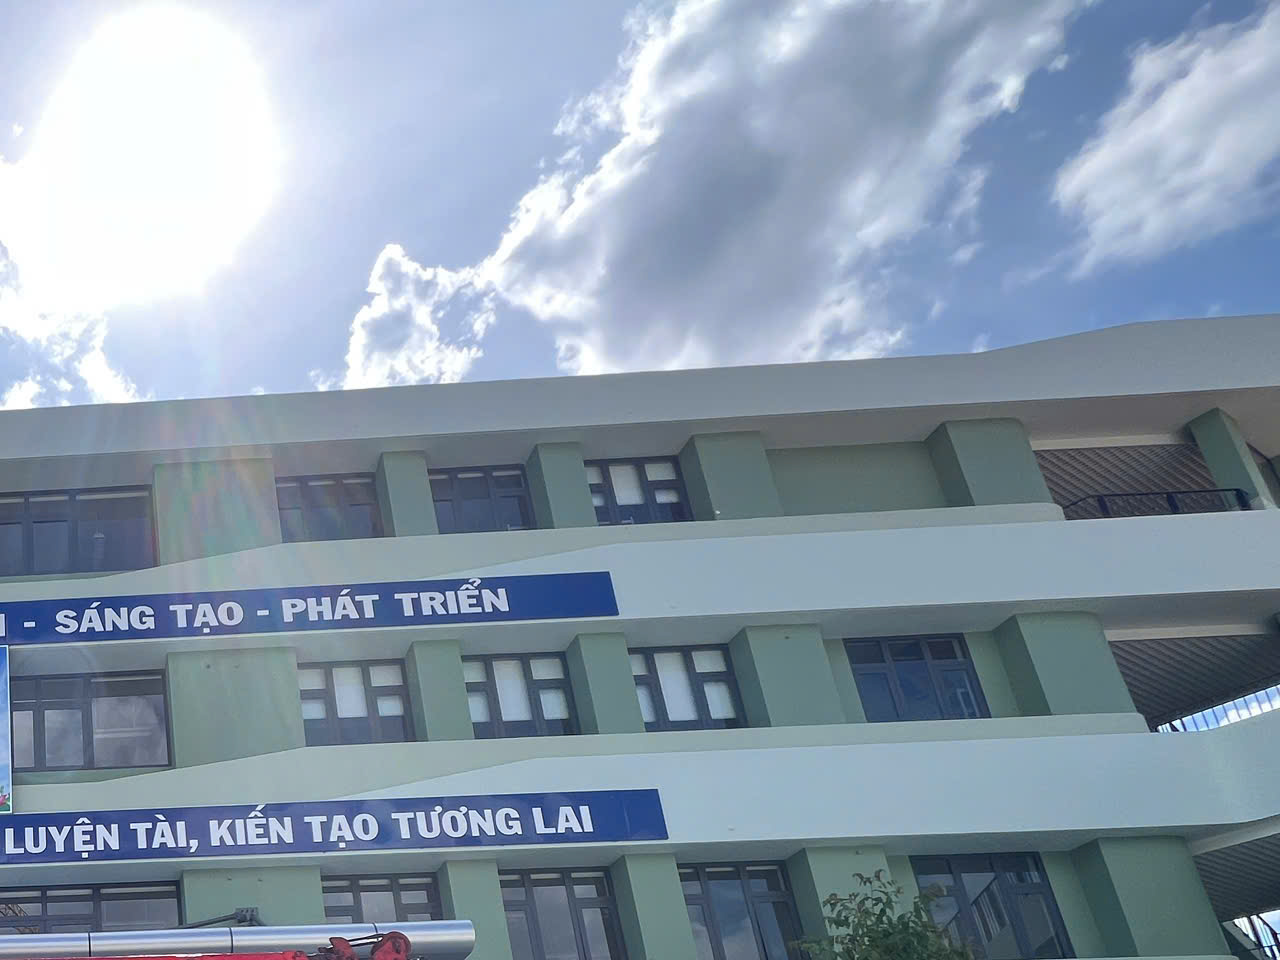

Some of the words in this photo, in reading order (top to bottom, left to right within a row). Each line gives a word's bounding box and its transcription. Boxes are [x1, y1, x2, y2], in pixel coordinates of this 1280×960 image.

[54, 601, 155, 634] SÁNG
[168, 601, 244, 633] TẠO
[281, 589, 380, 623] PHÁT
[394, 577, 510, 617] TRIỂN
[4, 817, 120, 859] LUYỆN
[129, 814, 199, 853] TÀI,
[208, 806, 294, 847] KIẾN
[303, 813, 379, 849] TẠO
[390, 805, 523, 839] TƯƠNG
[531, 805, 594, 834] LAI
